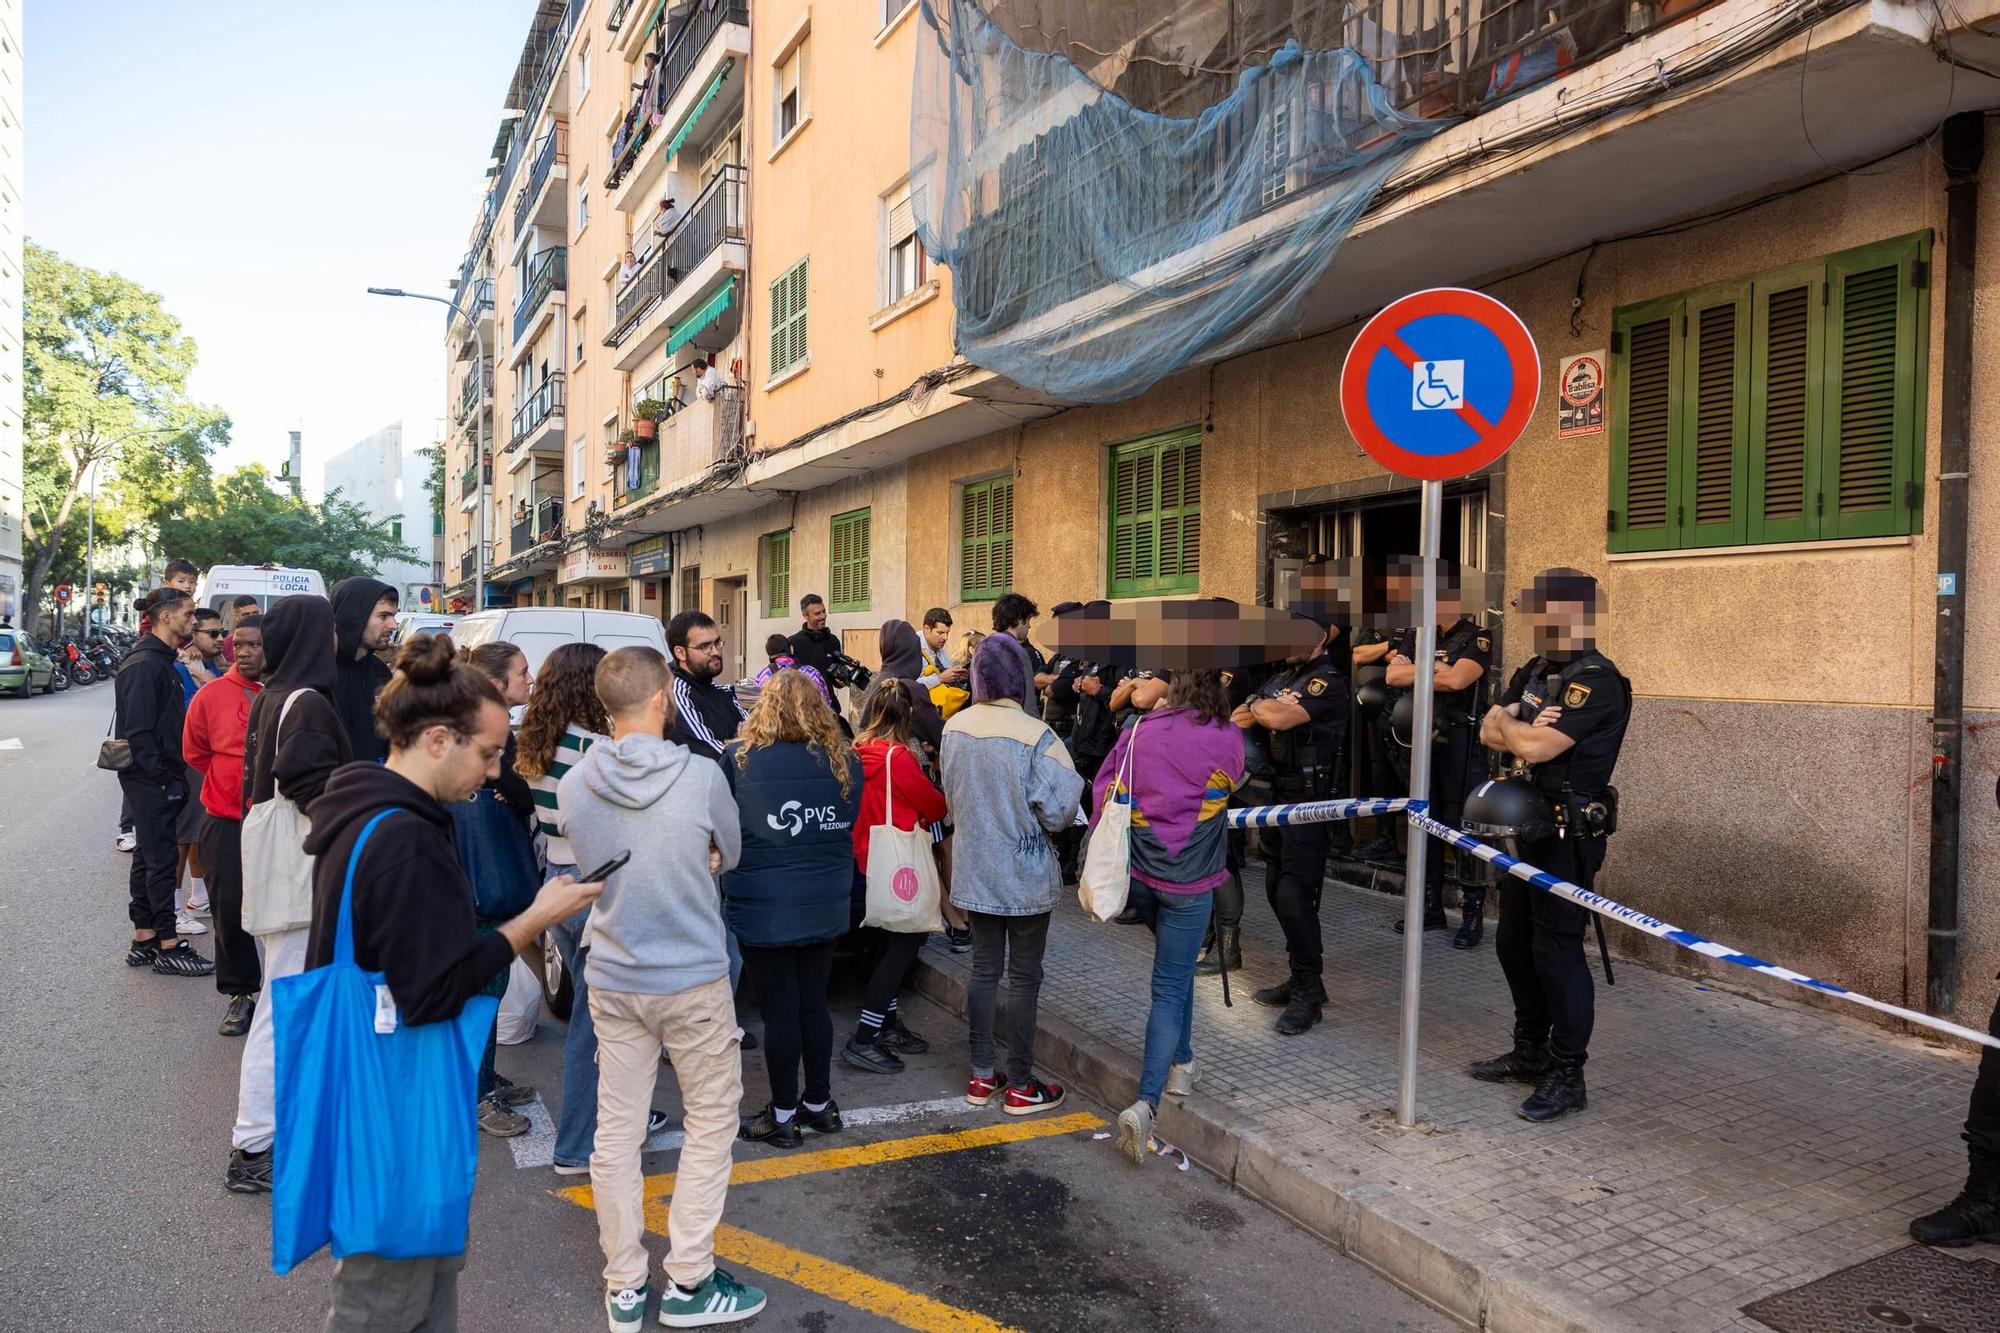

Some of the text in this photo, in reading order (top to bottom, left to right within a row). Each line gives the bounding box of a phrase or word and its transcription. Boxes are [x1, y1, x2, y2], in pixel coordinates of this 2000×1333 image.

[1567, 381, 1596, 393] Trablisa
[272, 575, 310, 583] POLICIA
[279, 583, 309, 592] LOCAL
[804, 806, 836, 824] PVS
